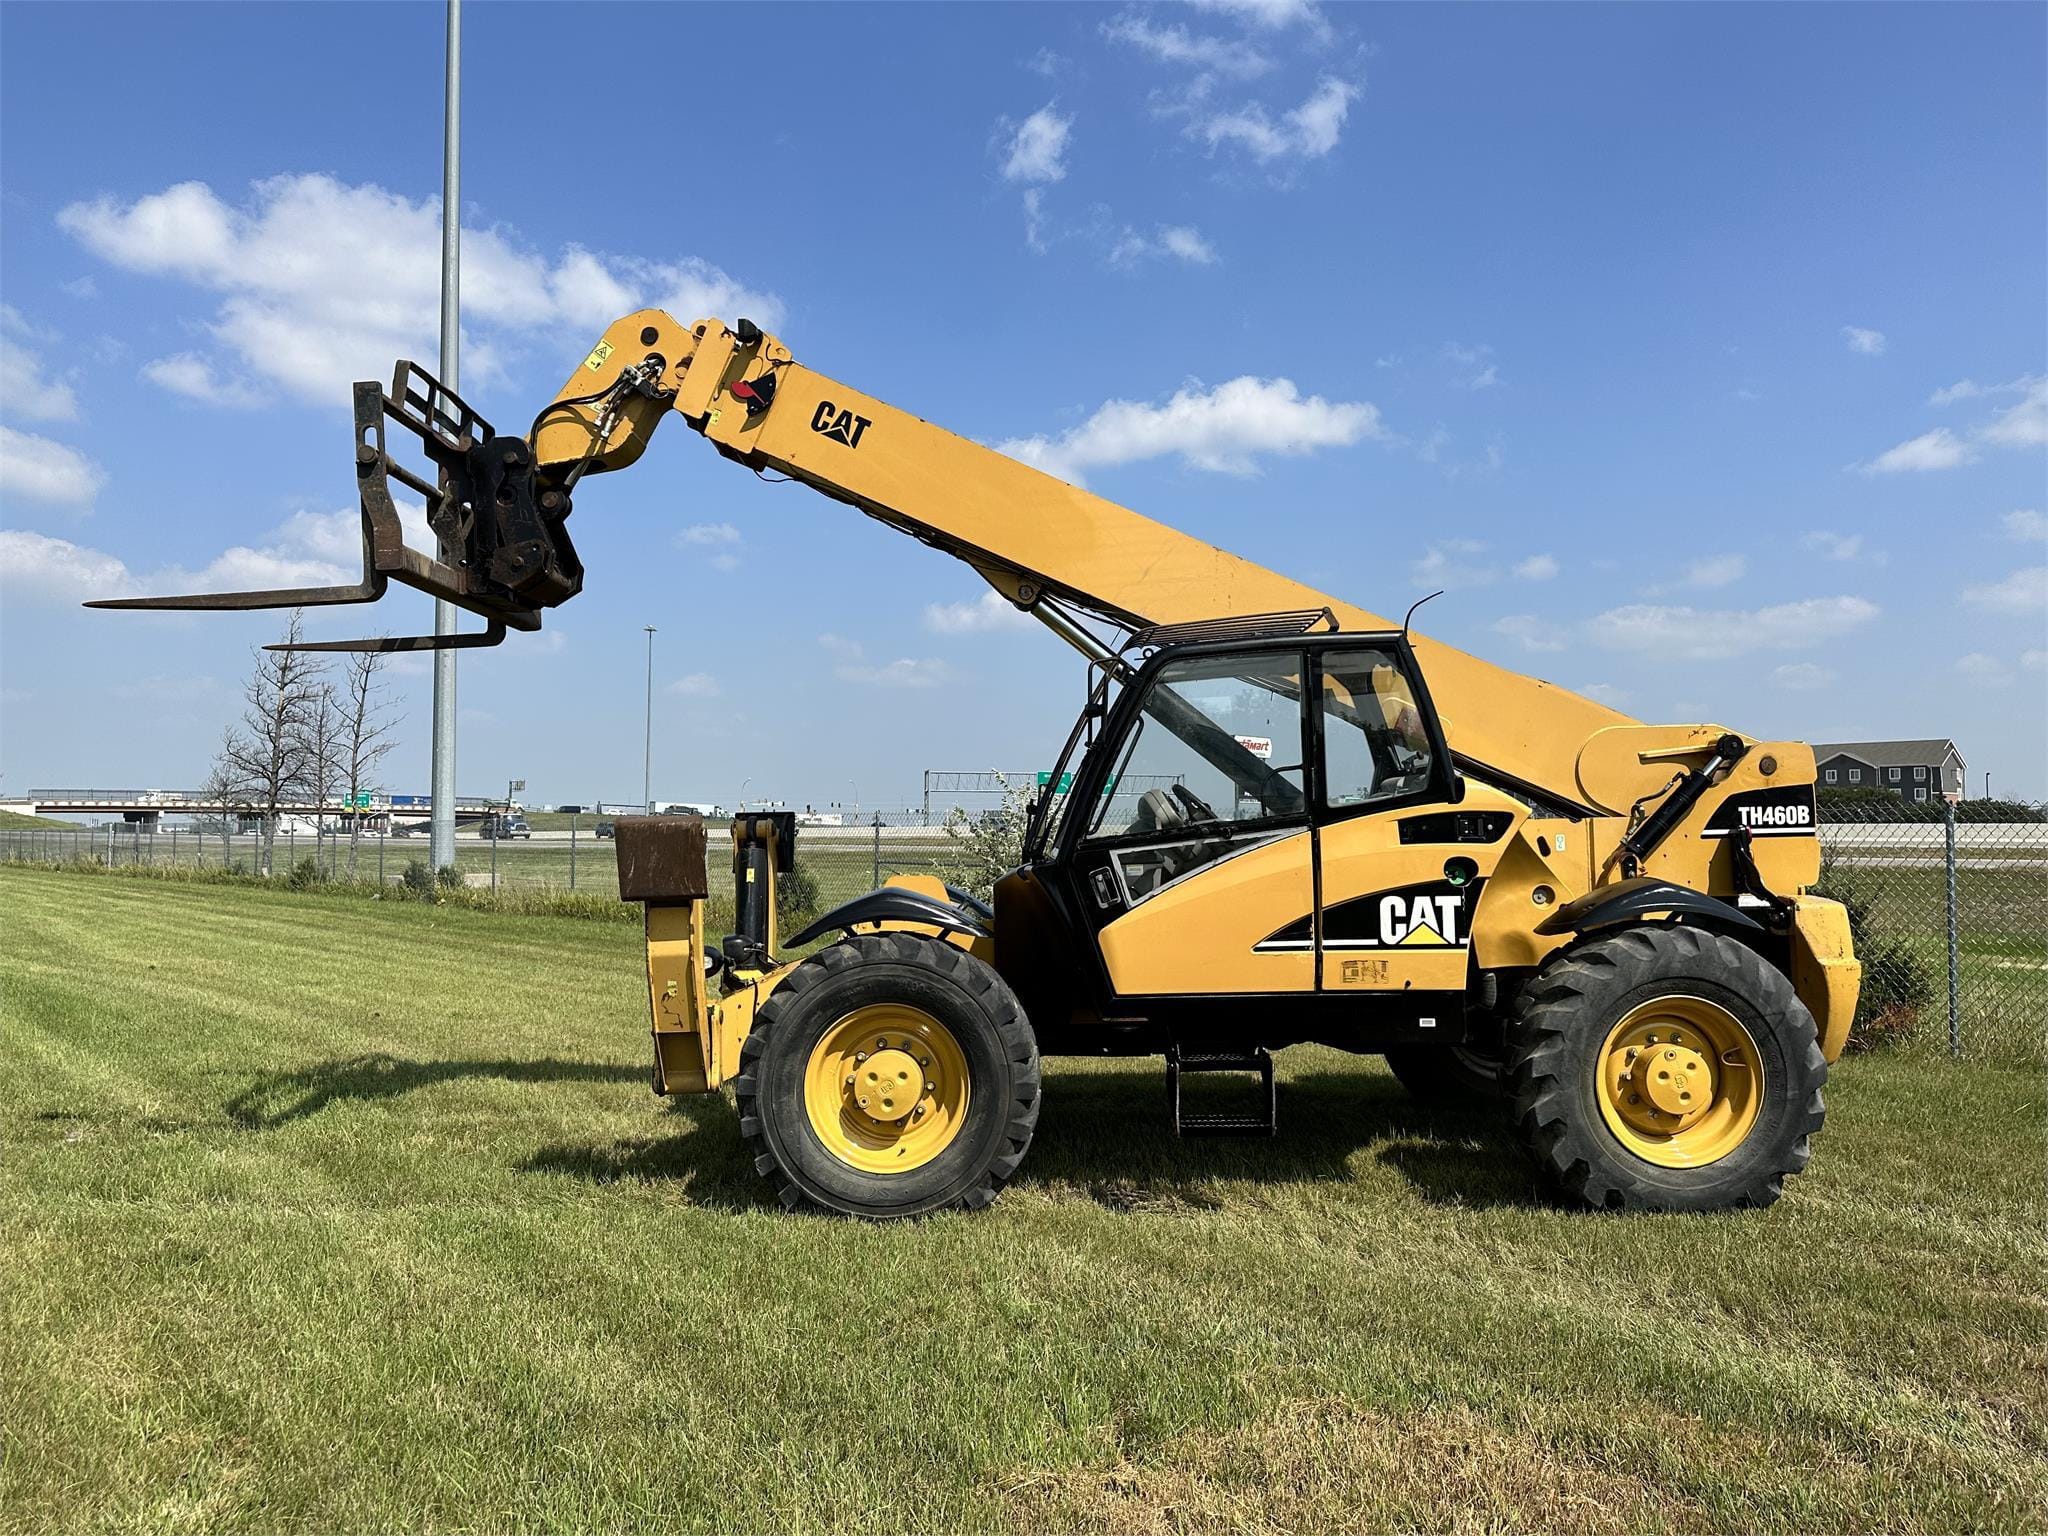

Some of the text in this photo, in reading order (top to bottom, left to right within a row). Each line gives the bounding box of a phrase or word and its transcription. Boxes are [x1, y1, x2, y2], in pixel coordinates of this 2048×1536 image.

[811, 401, 873, 449] CAT
[1738, 805, 1810, 826] TH460B
[1379, 895, 1462, 945] CAT
